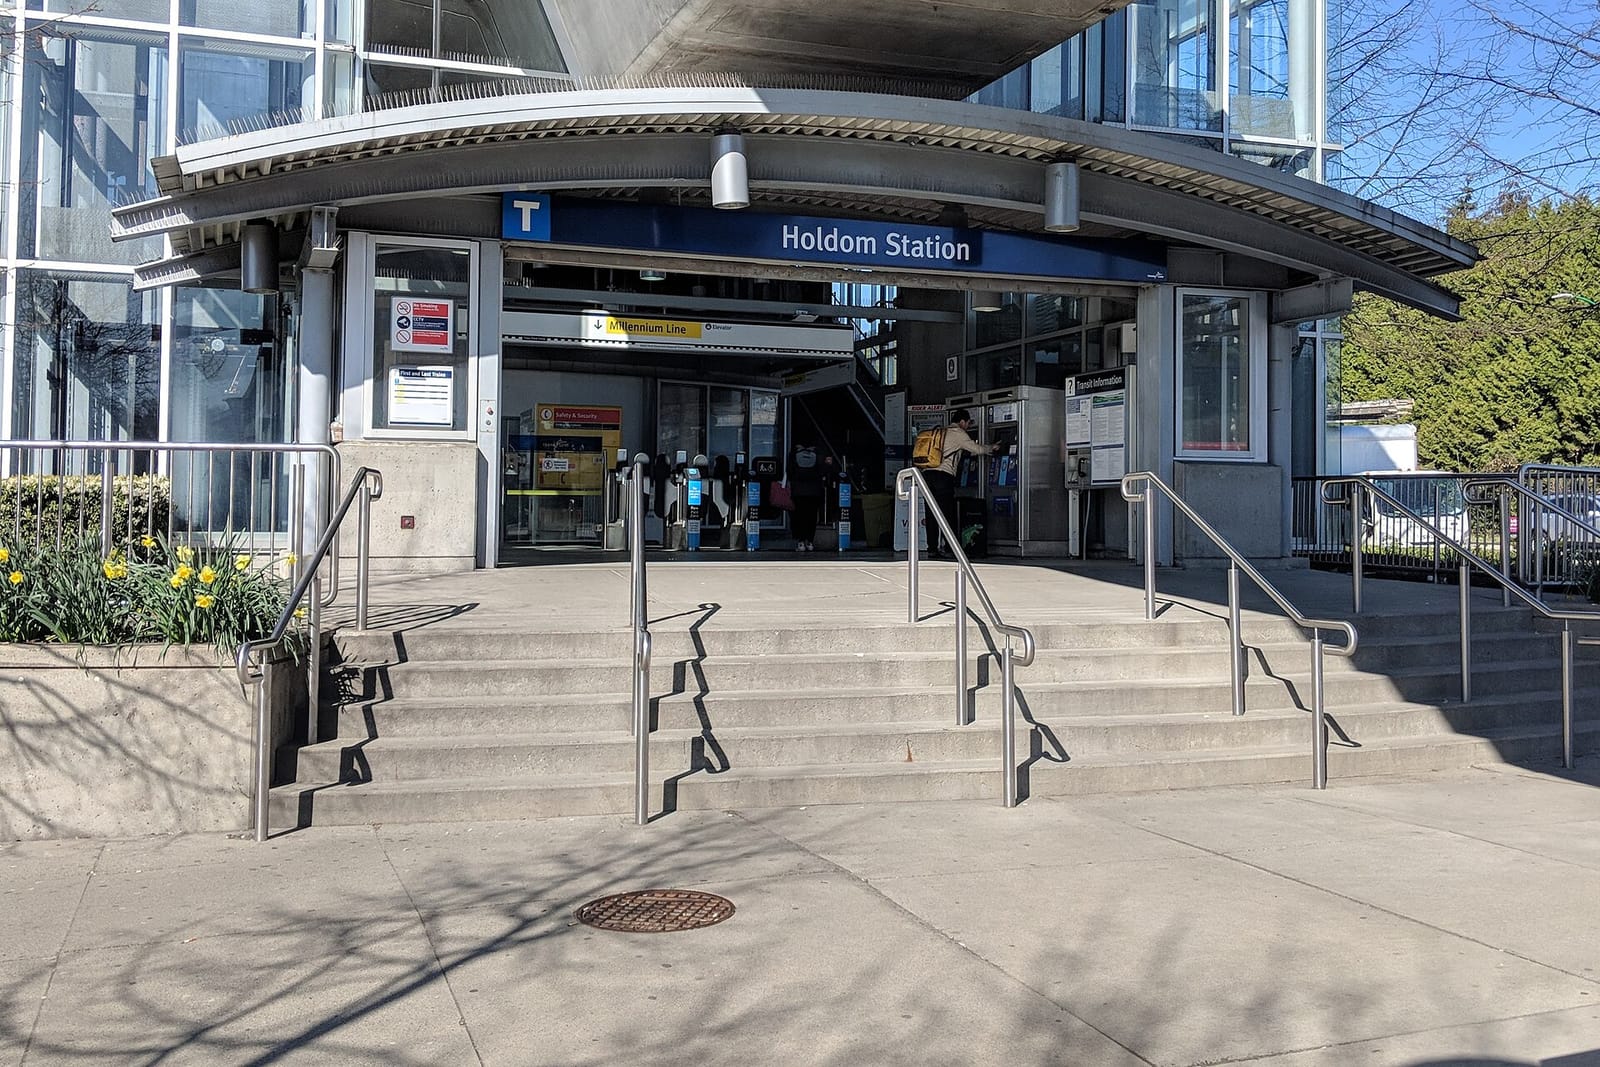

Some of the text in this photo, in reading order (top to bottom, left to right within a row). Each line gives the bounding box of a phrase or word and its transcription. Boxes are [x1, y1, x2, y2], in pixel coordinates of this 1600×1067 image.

[513, 200, 540, 232] T
[782, 224, 970, 261] Holdom Station
[609, 320, 687, 334] Millennium Line
[1076, 374, 1123, 390] Transit Information
